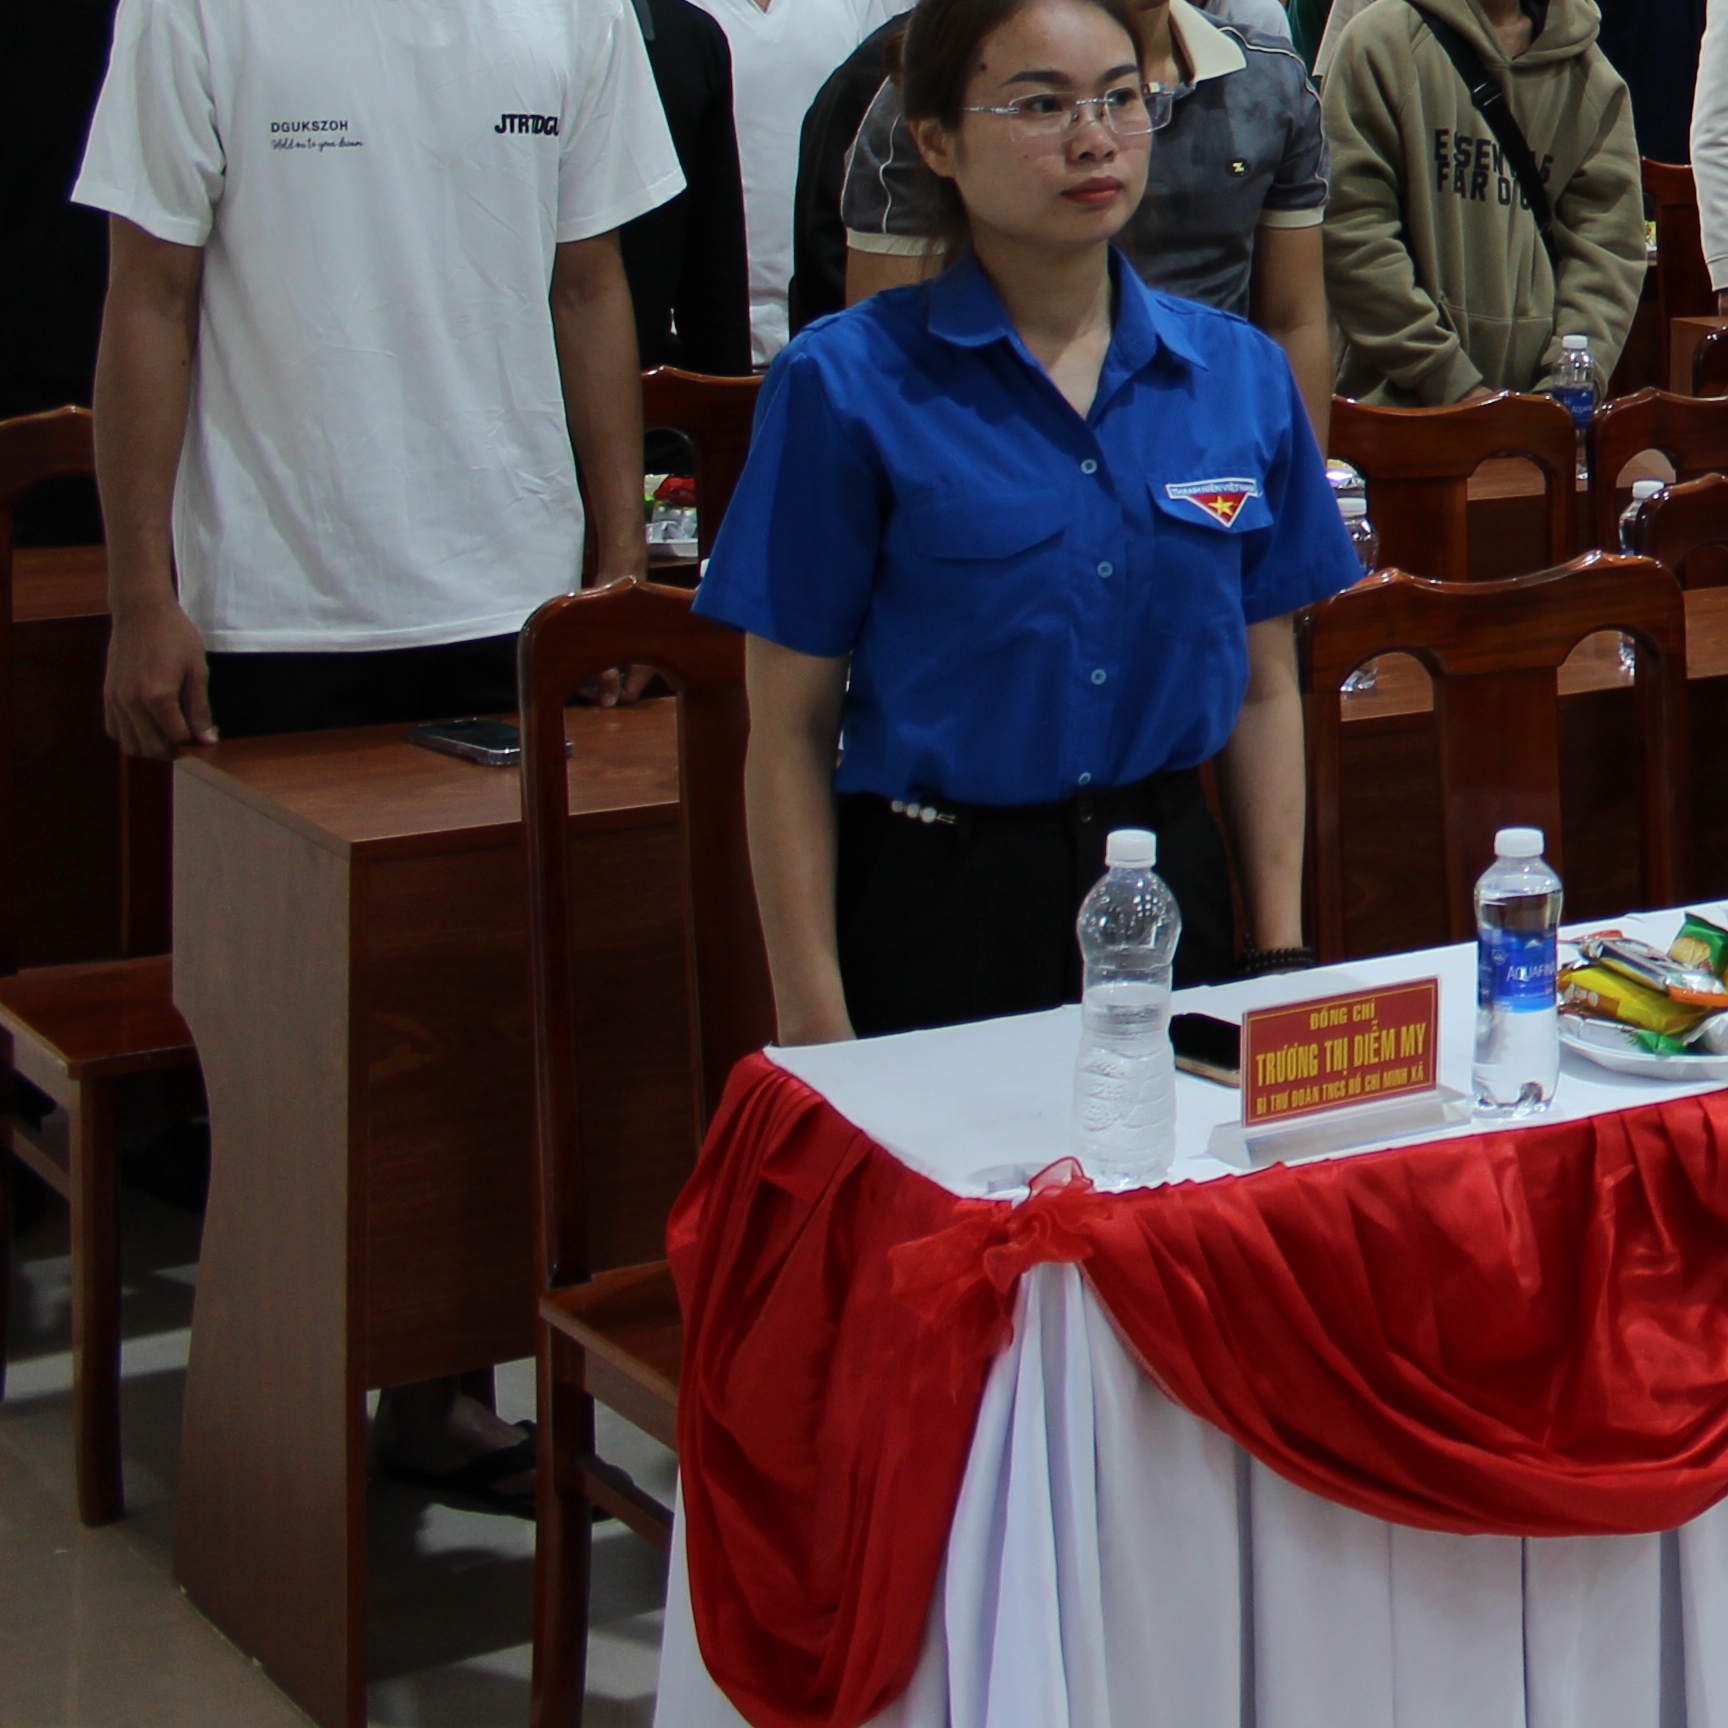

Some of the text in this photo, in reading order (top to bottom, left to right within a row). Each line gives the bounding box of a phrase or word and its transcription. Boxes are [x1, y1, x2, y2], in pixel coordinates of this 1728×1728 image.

[271, 120, 349, 132] DGUKSZOH
[1310, 999, 1375, 1030] ĐỒNG CHÍ
[1324, 1037, 1348, 1076] THỊ
[1353, 1020, 1395, 1067] DIỄM
[1400, 1023, 1426, 1059] MY
[1271, 1090, 1290, 1112] THƯ
[1291, 1086, 1320, 1107] ĐOÀN
[1322, 1084, 1346, 1103] TNCS
[1365, 1070, 1381, 1092] CHÍ
[1383, 1068, 1408, 1088] MINH
[1410, 1061, 1425, 1083] XÃ
